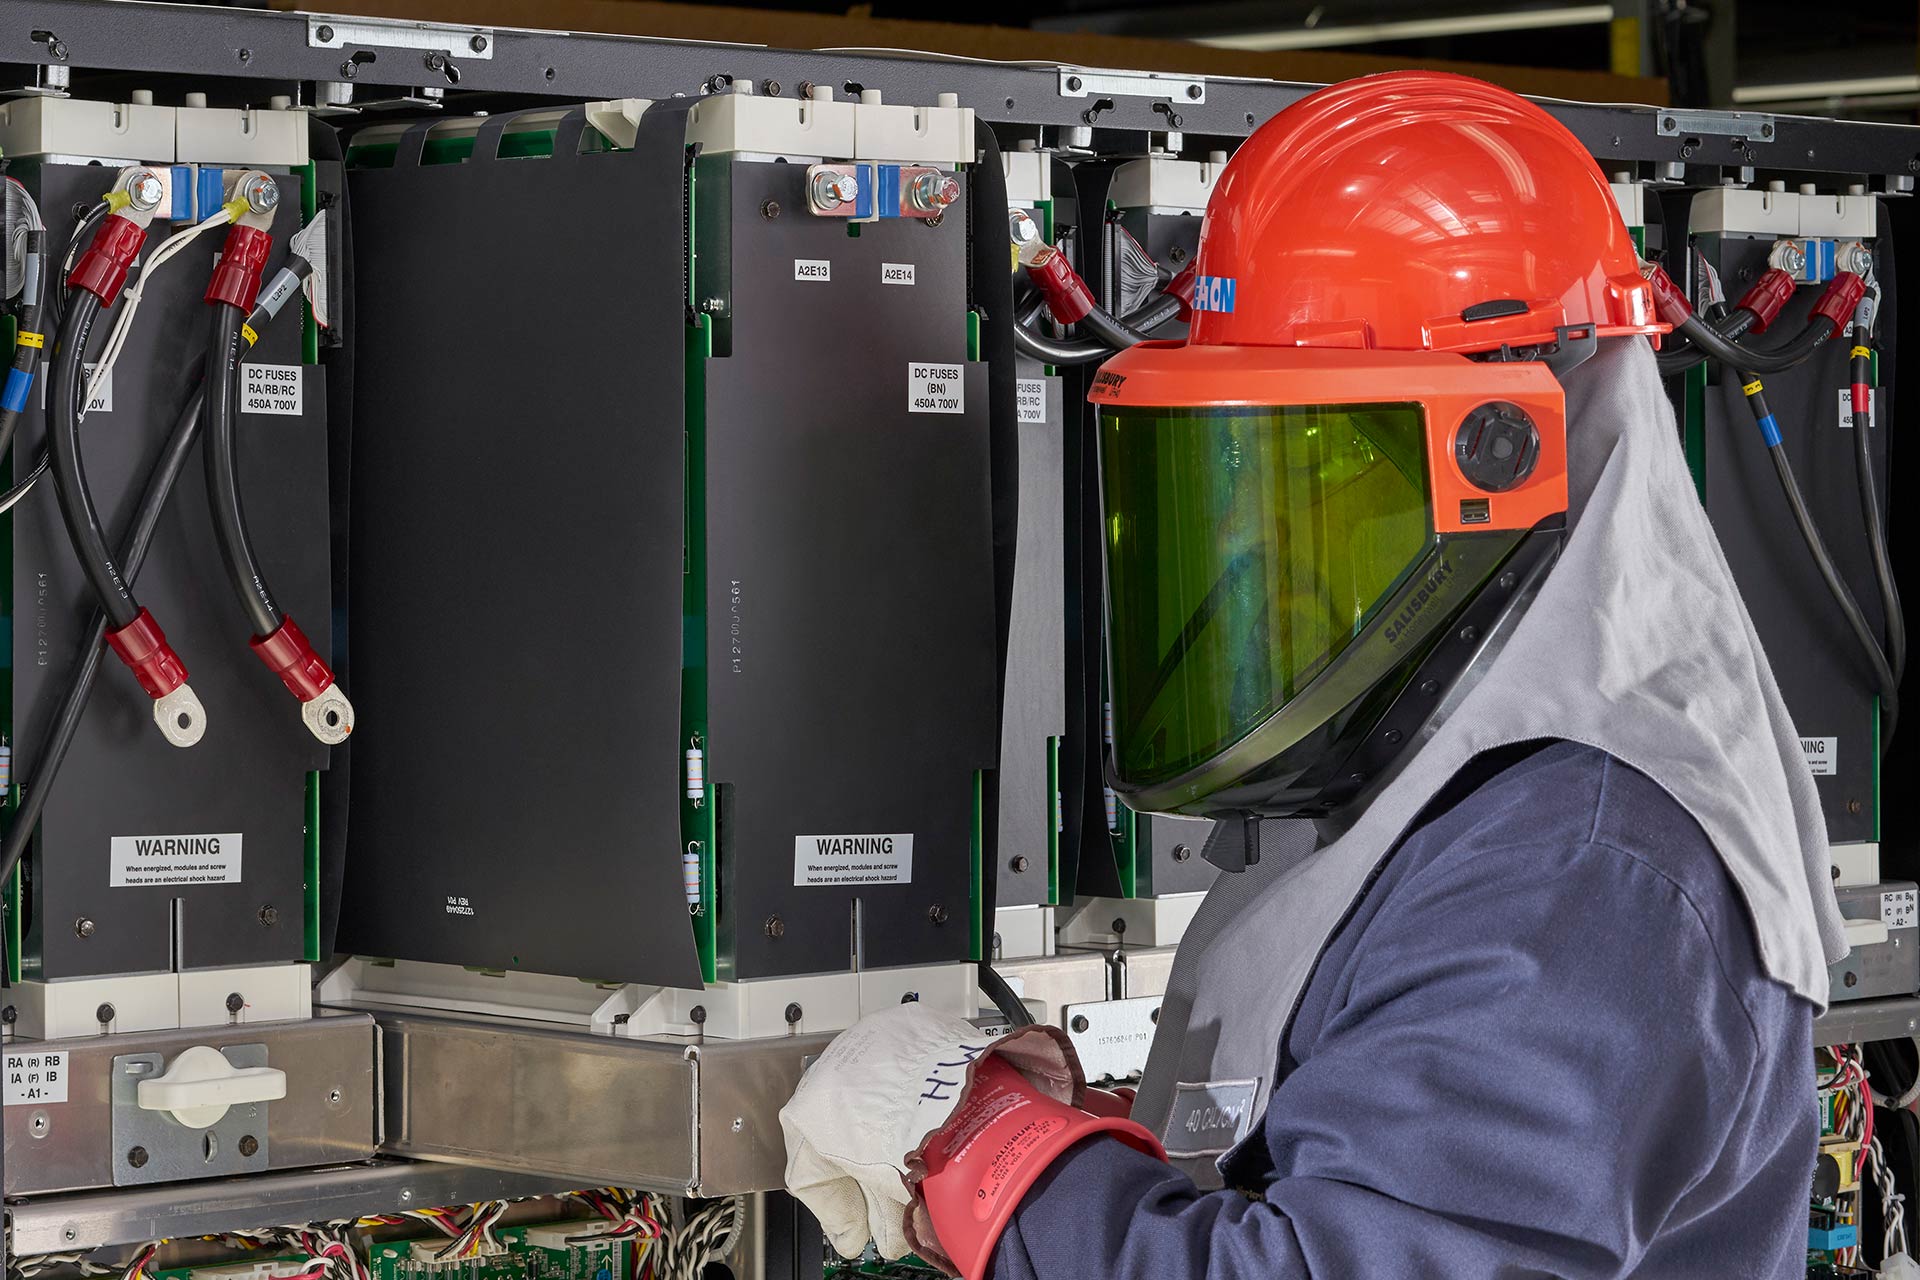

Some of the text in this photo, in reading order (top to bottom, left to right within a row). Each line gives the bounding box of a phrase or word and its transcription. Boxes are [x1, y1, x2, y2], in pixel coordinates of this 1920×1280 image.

[797, 265, 828, 277] A2E13
[884, 269, 913, 280] A2E14
[272, 285, 288, 302] L2P2
[248, 368, 297, 381] DC FUSES
[914, 368, 959, 380] DC FUSES
[248, 384, 296, 396] RA/RB/RC
[927, 382, 947, 396] (BN)
[1017, 383, 1042, 394] FUSES
[247, 399, 297, 410] 450A 700V
[914, 398, 959, 409] 450A 700V
[1023, 410, 1042, 419] 700V
[105, 561, 129, 599] A2E13
[253, 575, 273, 611] A2E14
[1384, 560, 1453, 643] SALISBURY
[1800, 740, 1825, 753] NING
[135, 838, 221, 856] WARNING
[816, 837, 893, 855] WARNING
[125, 865, 142, 873] When
[143, 865, 173, 873] energized,
[173, 864, 198, 872] modules
[198, 863, 209, 871] and
[823, 864, 851, 872] energized,
[851, 863, 873, 871] modules
[163, 875, 189, 883] electrical
[1884, 893, 1894, 902] RC
[1884, 908, 1892, 916] IC
[1895, 918, 1904, 926] A2
[8, 1056, 60, 1068] RA (R) RB
[11, 1071, 57, 1084] IA (F) IB
[27, 1088, 41, 1099] A1
[1185, 1109, 1201, 1133] 40
[991, 1120, 1036, 1167] SALISBURY
[977, 1188, 987, 1200] 9
